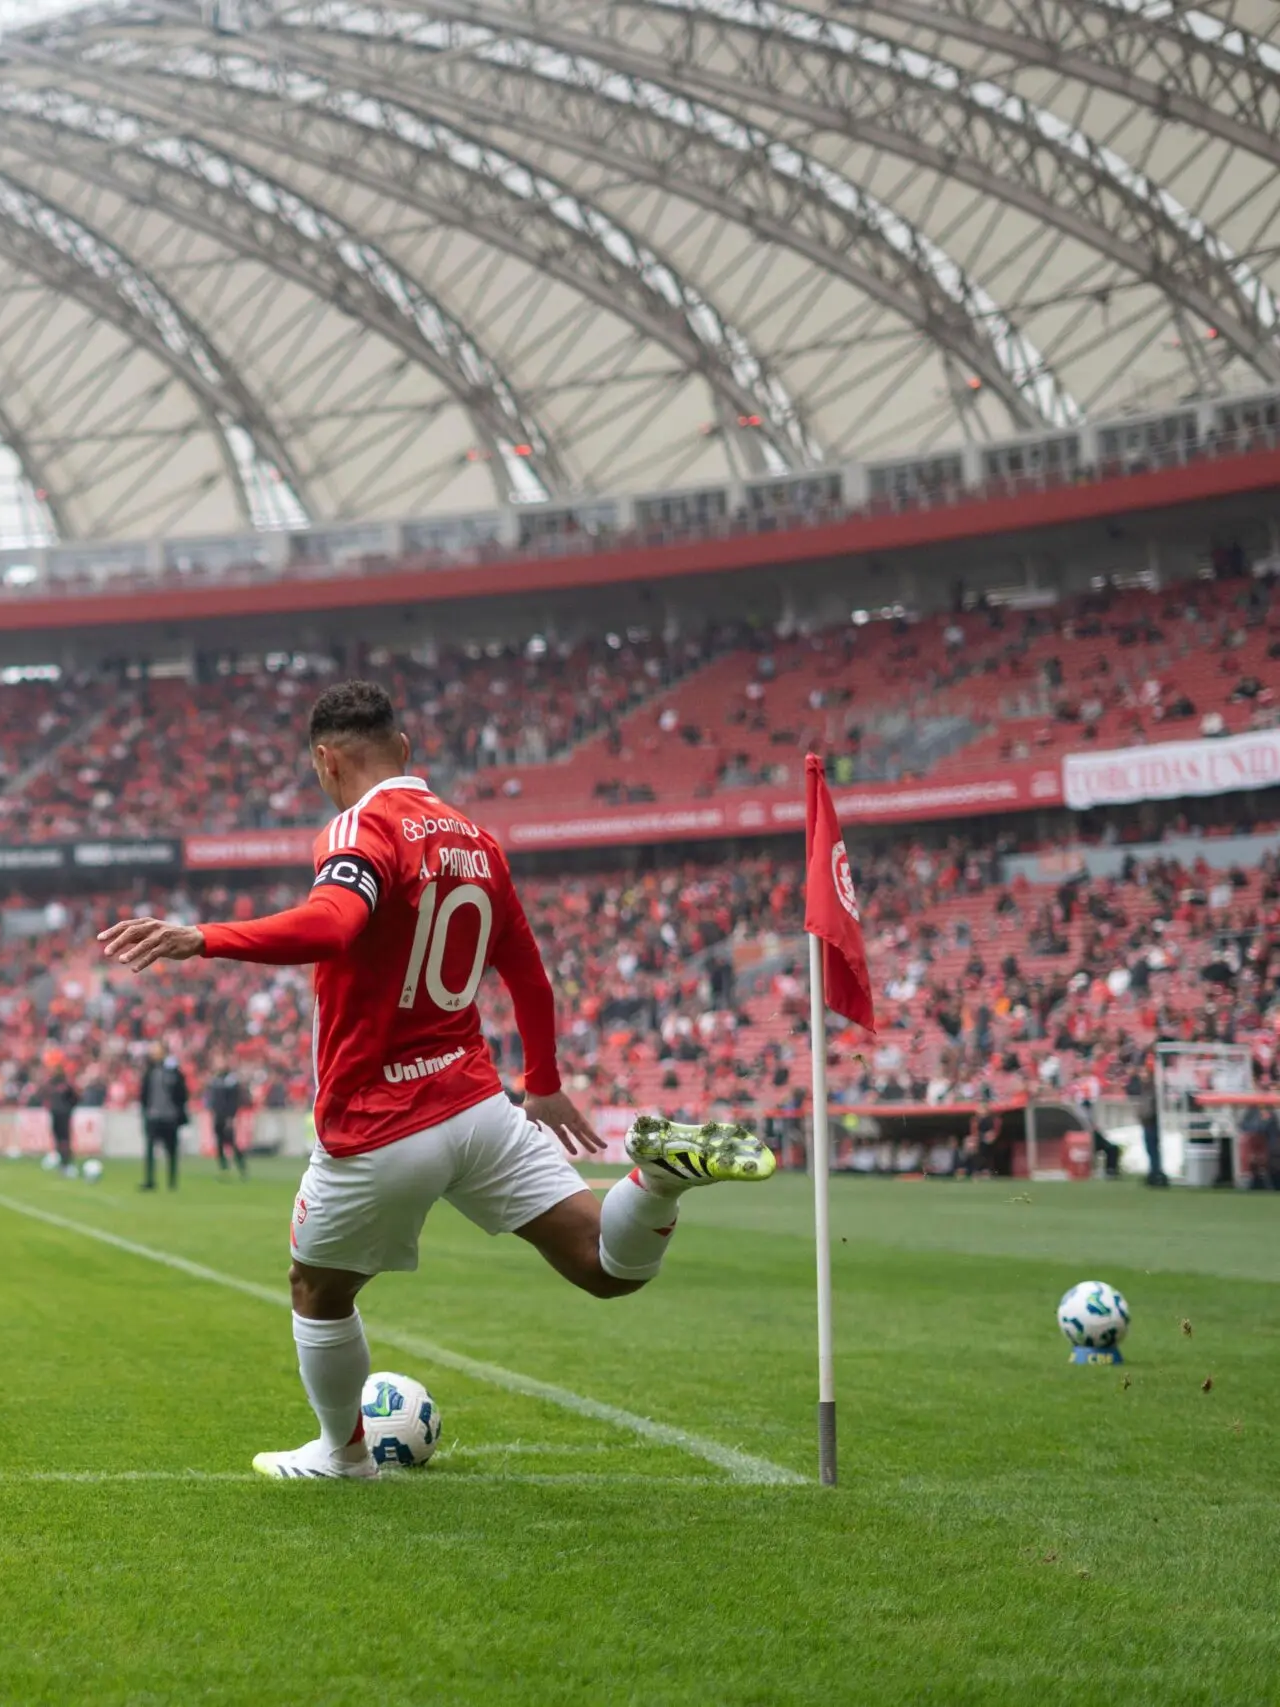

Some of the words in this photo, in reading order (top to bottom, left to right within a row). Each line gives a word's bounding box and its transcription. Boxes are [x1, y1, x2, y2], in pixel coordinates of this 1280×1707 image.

[332, 861, 359, 883] C
[438, 847, 492, 879] PATRICK
[398, 881, 493, 1012] 10
